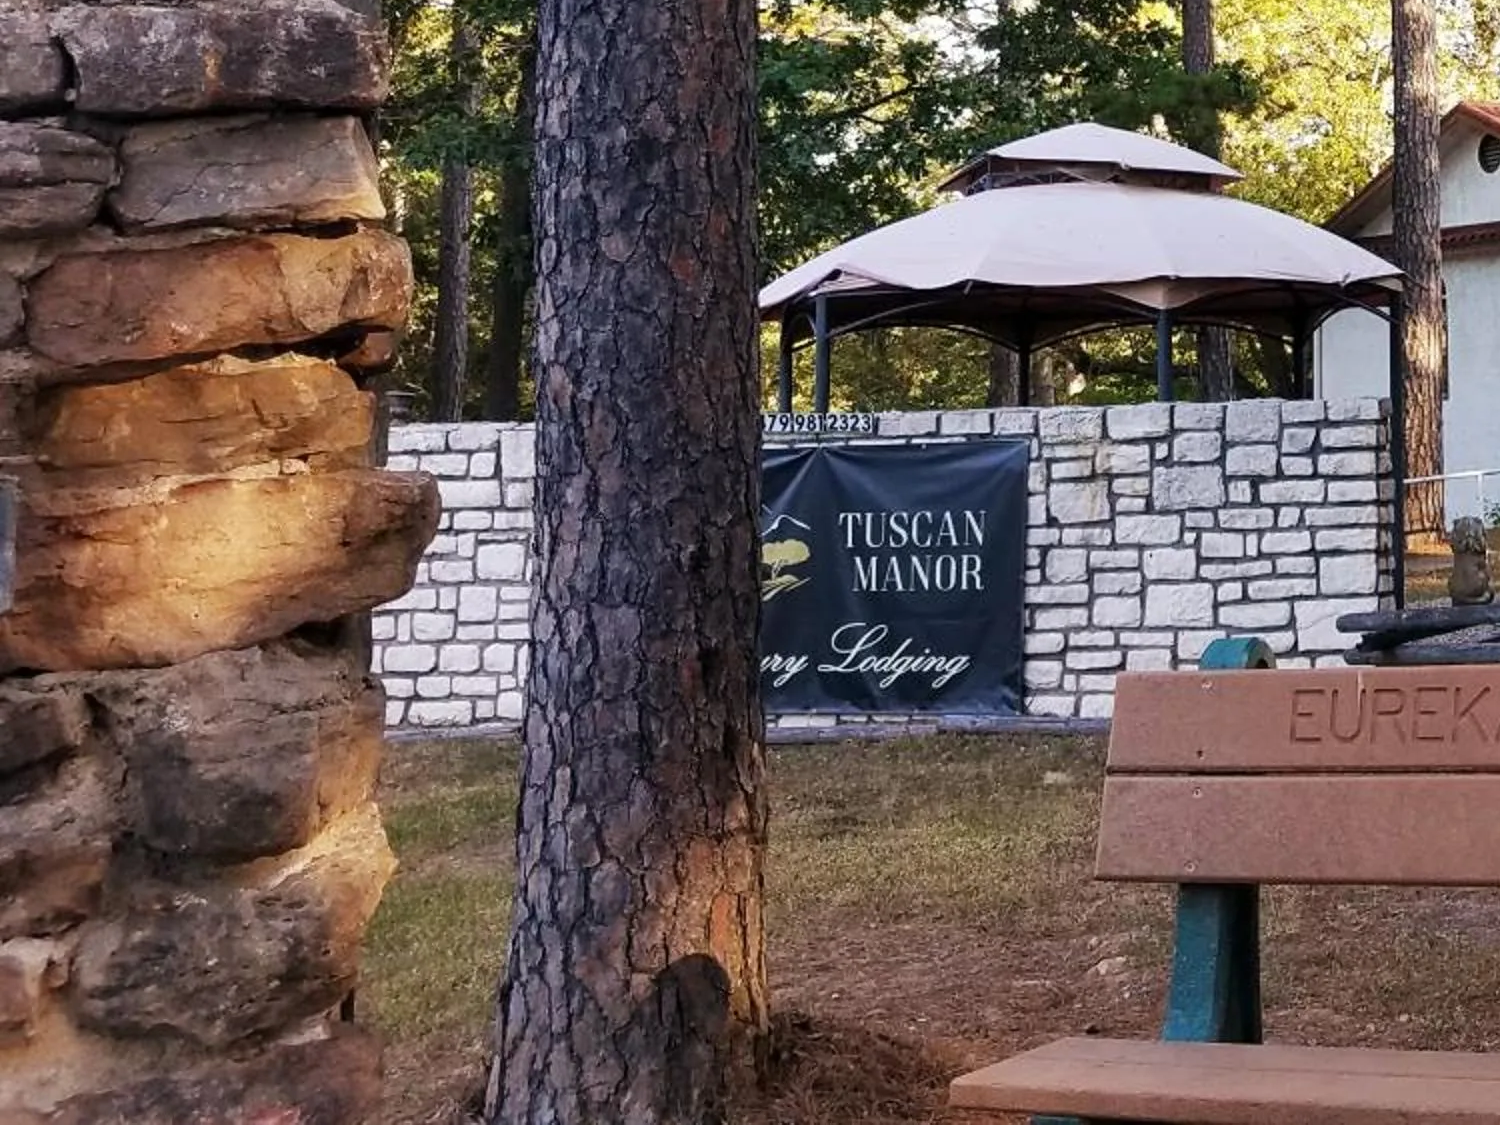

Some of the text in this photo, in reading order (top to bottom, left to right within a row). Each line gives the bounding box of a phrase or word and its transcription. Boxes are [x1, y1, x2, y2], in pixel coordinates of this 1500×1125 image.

[839, 510, 986, 548] TUSCAN
[851, 554, 985, 592] MANOR
[817, 622, 971, 688] Lodging
